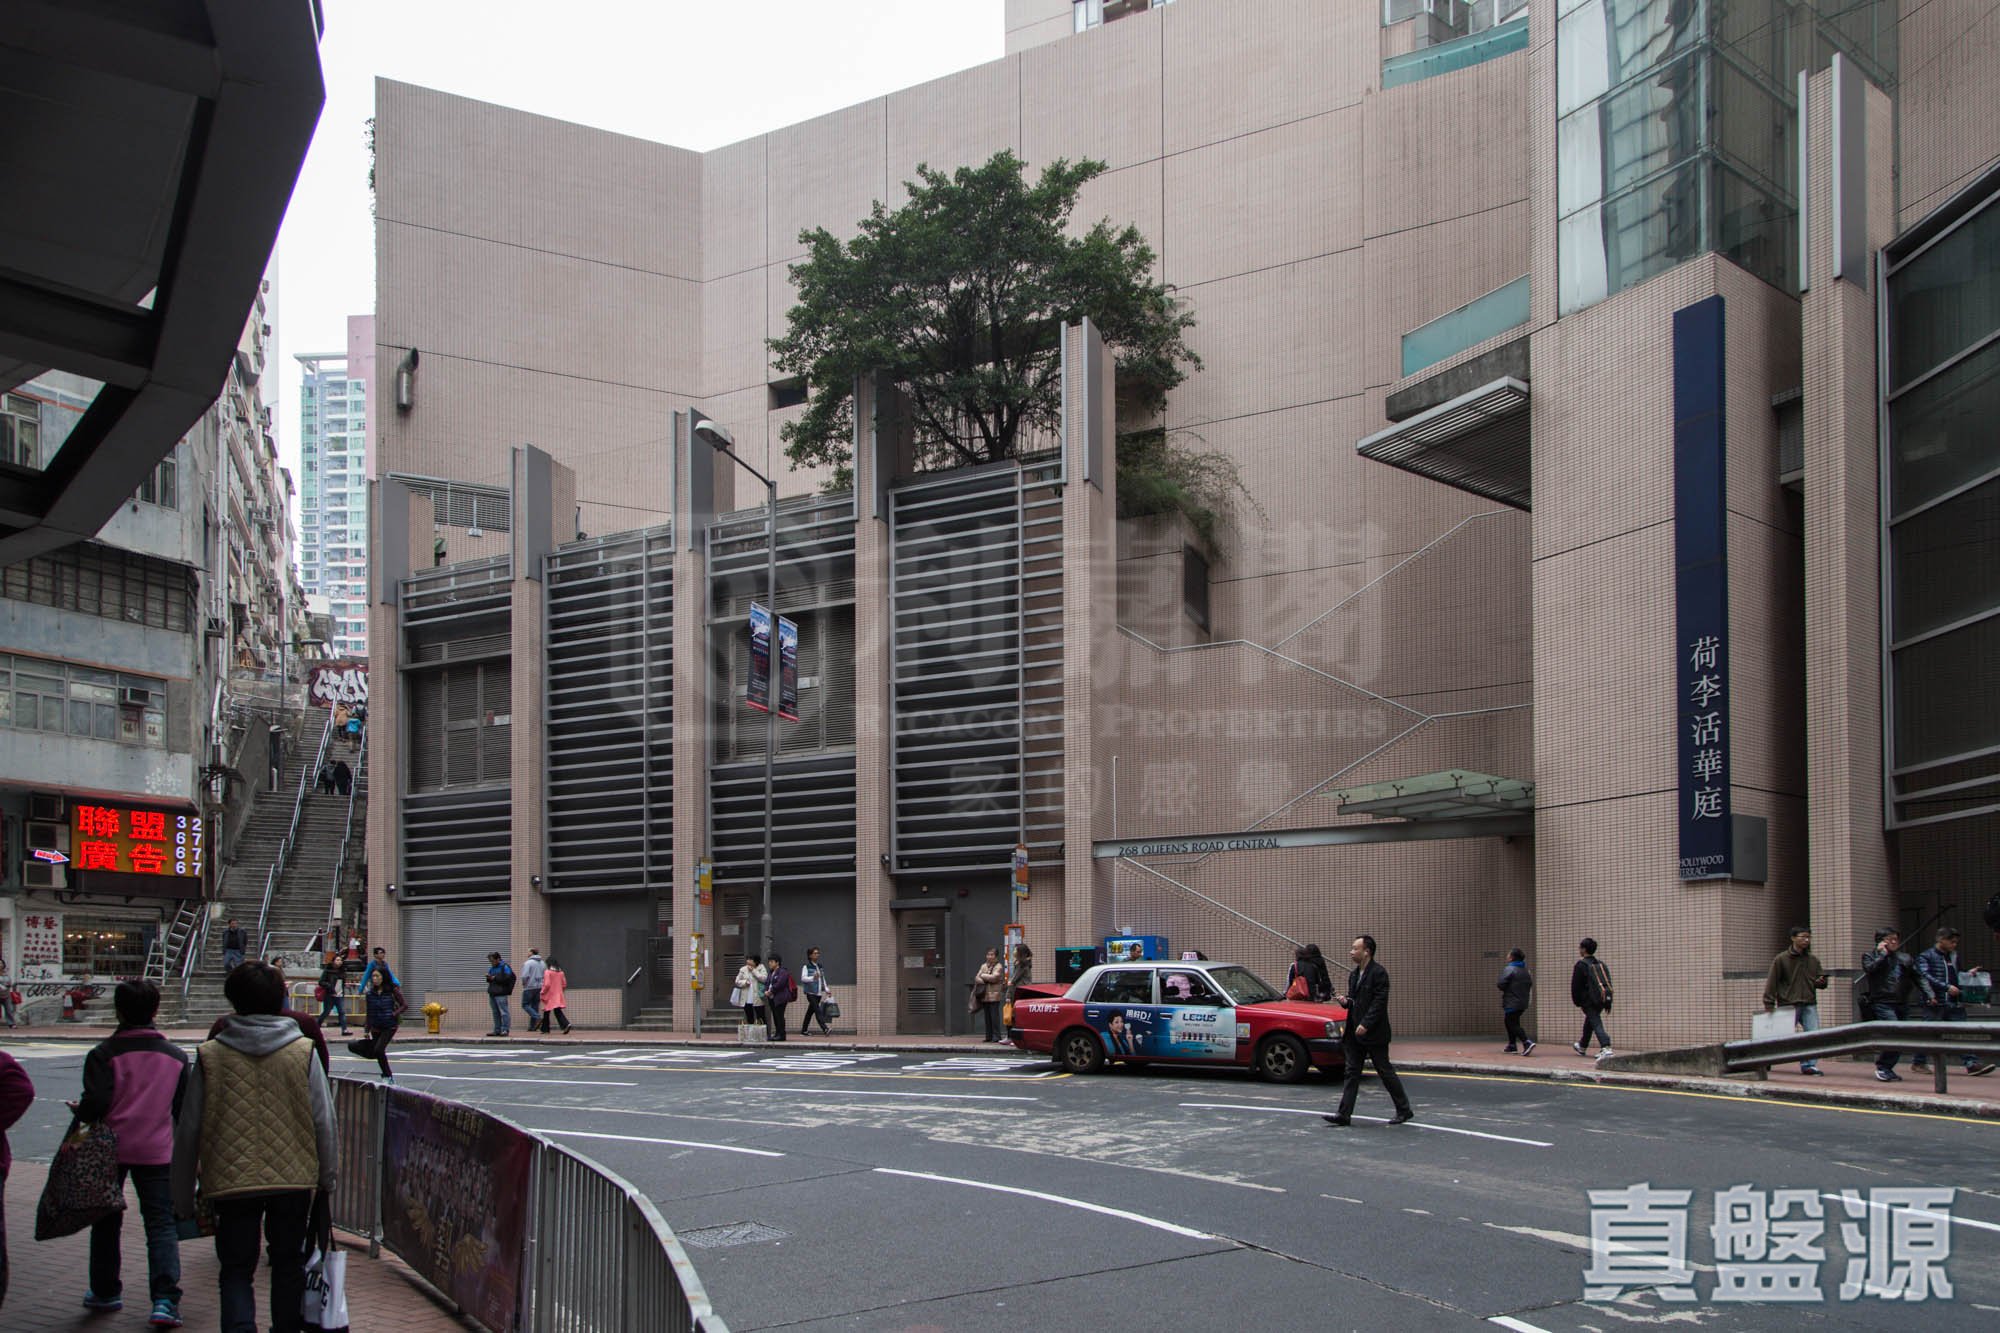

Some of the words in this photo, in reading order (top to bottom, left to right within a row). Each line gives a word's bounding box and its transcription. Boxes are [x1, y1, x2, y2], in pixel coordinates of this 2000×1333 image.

[1689, 636, 1724, 822] 荷李活華庭
[77, 805, 168, 842] 聯盟
[1119, 846, 1139, 856] 268
[1142, 842, 1189, 855] QUEEN'S
[1192, 840, 1224, 854] ROAD
[1228, 838, 1280, 850] CENTRAL
[77, 840, 168, 875] 廣告
[1680, 854, 1724, 868] HOLLYWOOD
[1680, 866, 1707, 877] TERRACE
[1029, 1004, 1043, 1013] TAXI
[1044, 1004, 1060, 1013] 的士
[743, 1051, 898, 1070] STOP
[901, 1056, 1053, 1072] BUS
